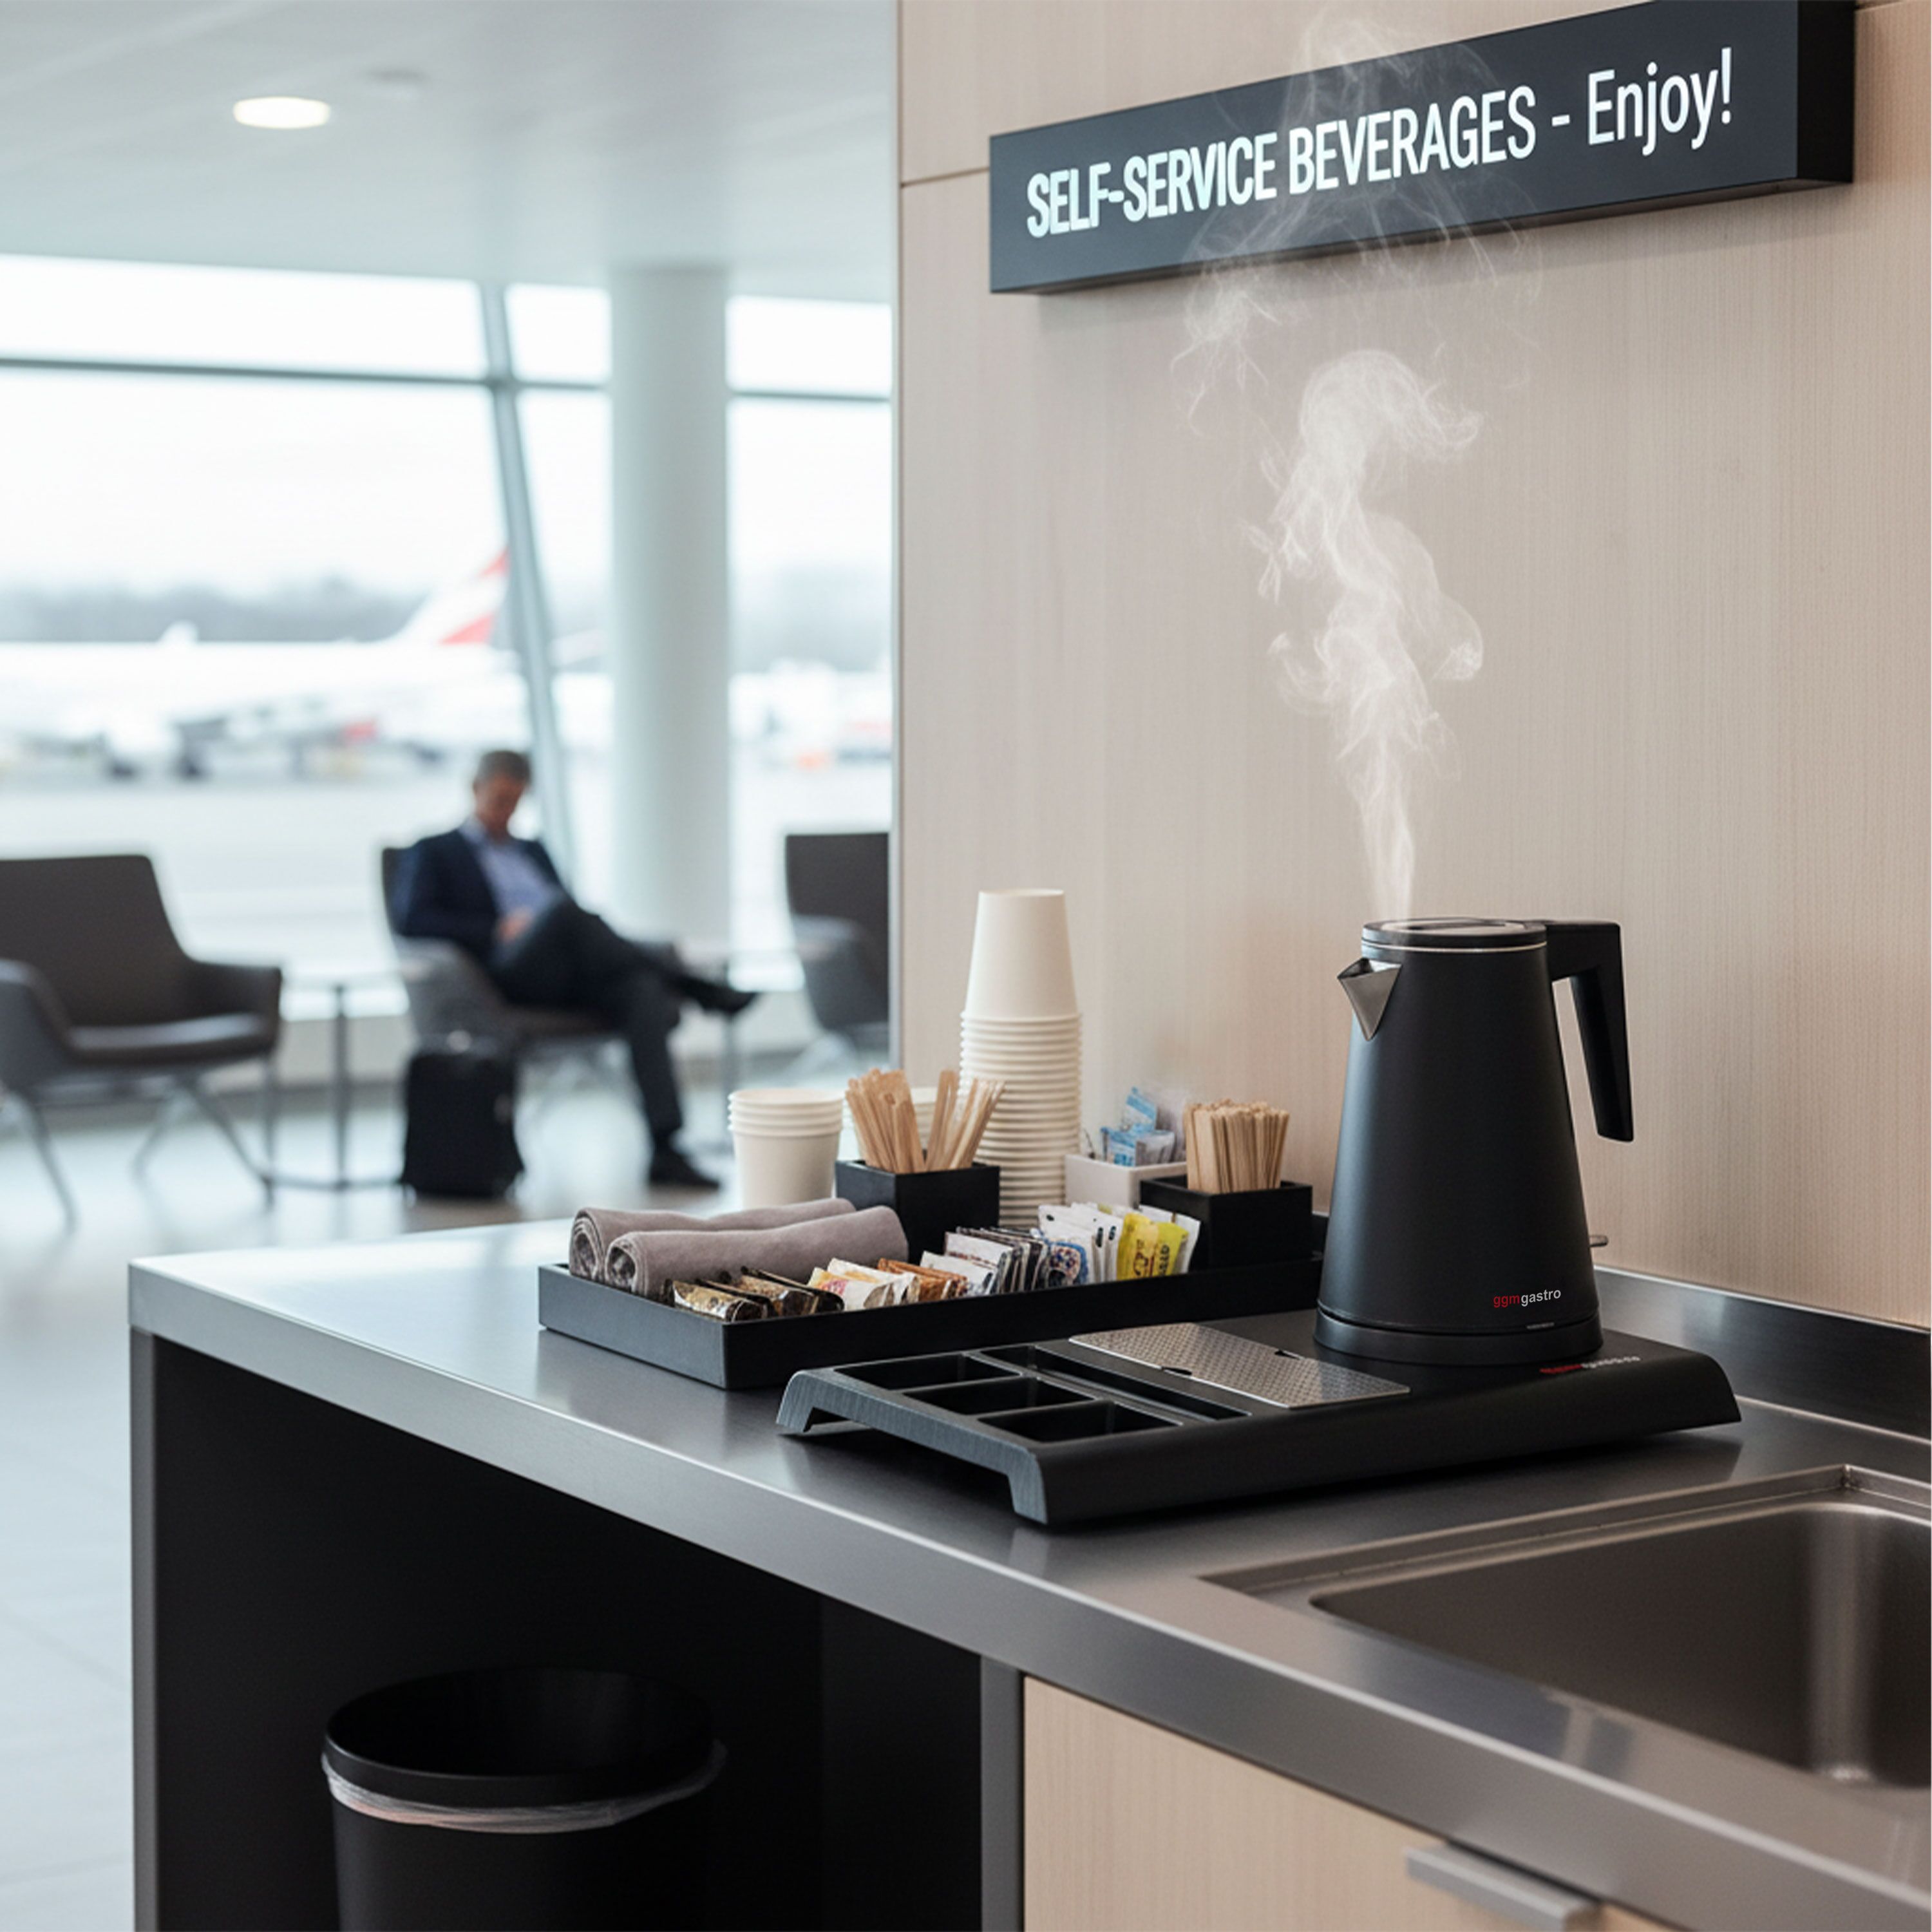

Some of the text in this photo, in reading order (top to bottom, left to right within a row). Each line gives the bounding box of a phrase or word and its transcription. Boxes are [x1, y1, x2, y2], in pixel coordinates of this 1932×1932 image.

[1027, 47, 1731, 238] SELF-SERVICE BEVERAGES - Enjoy!
[1493, 1289, 1561, 1308] ggmgastro
